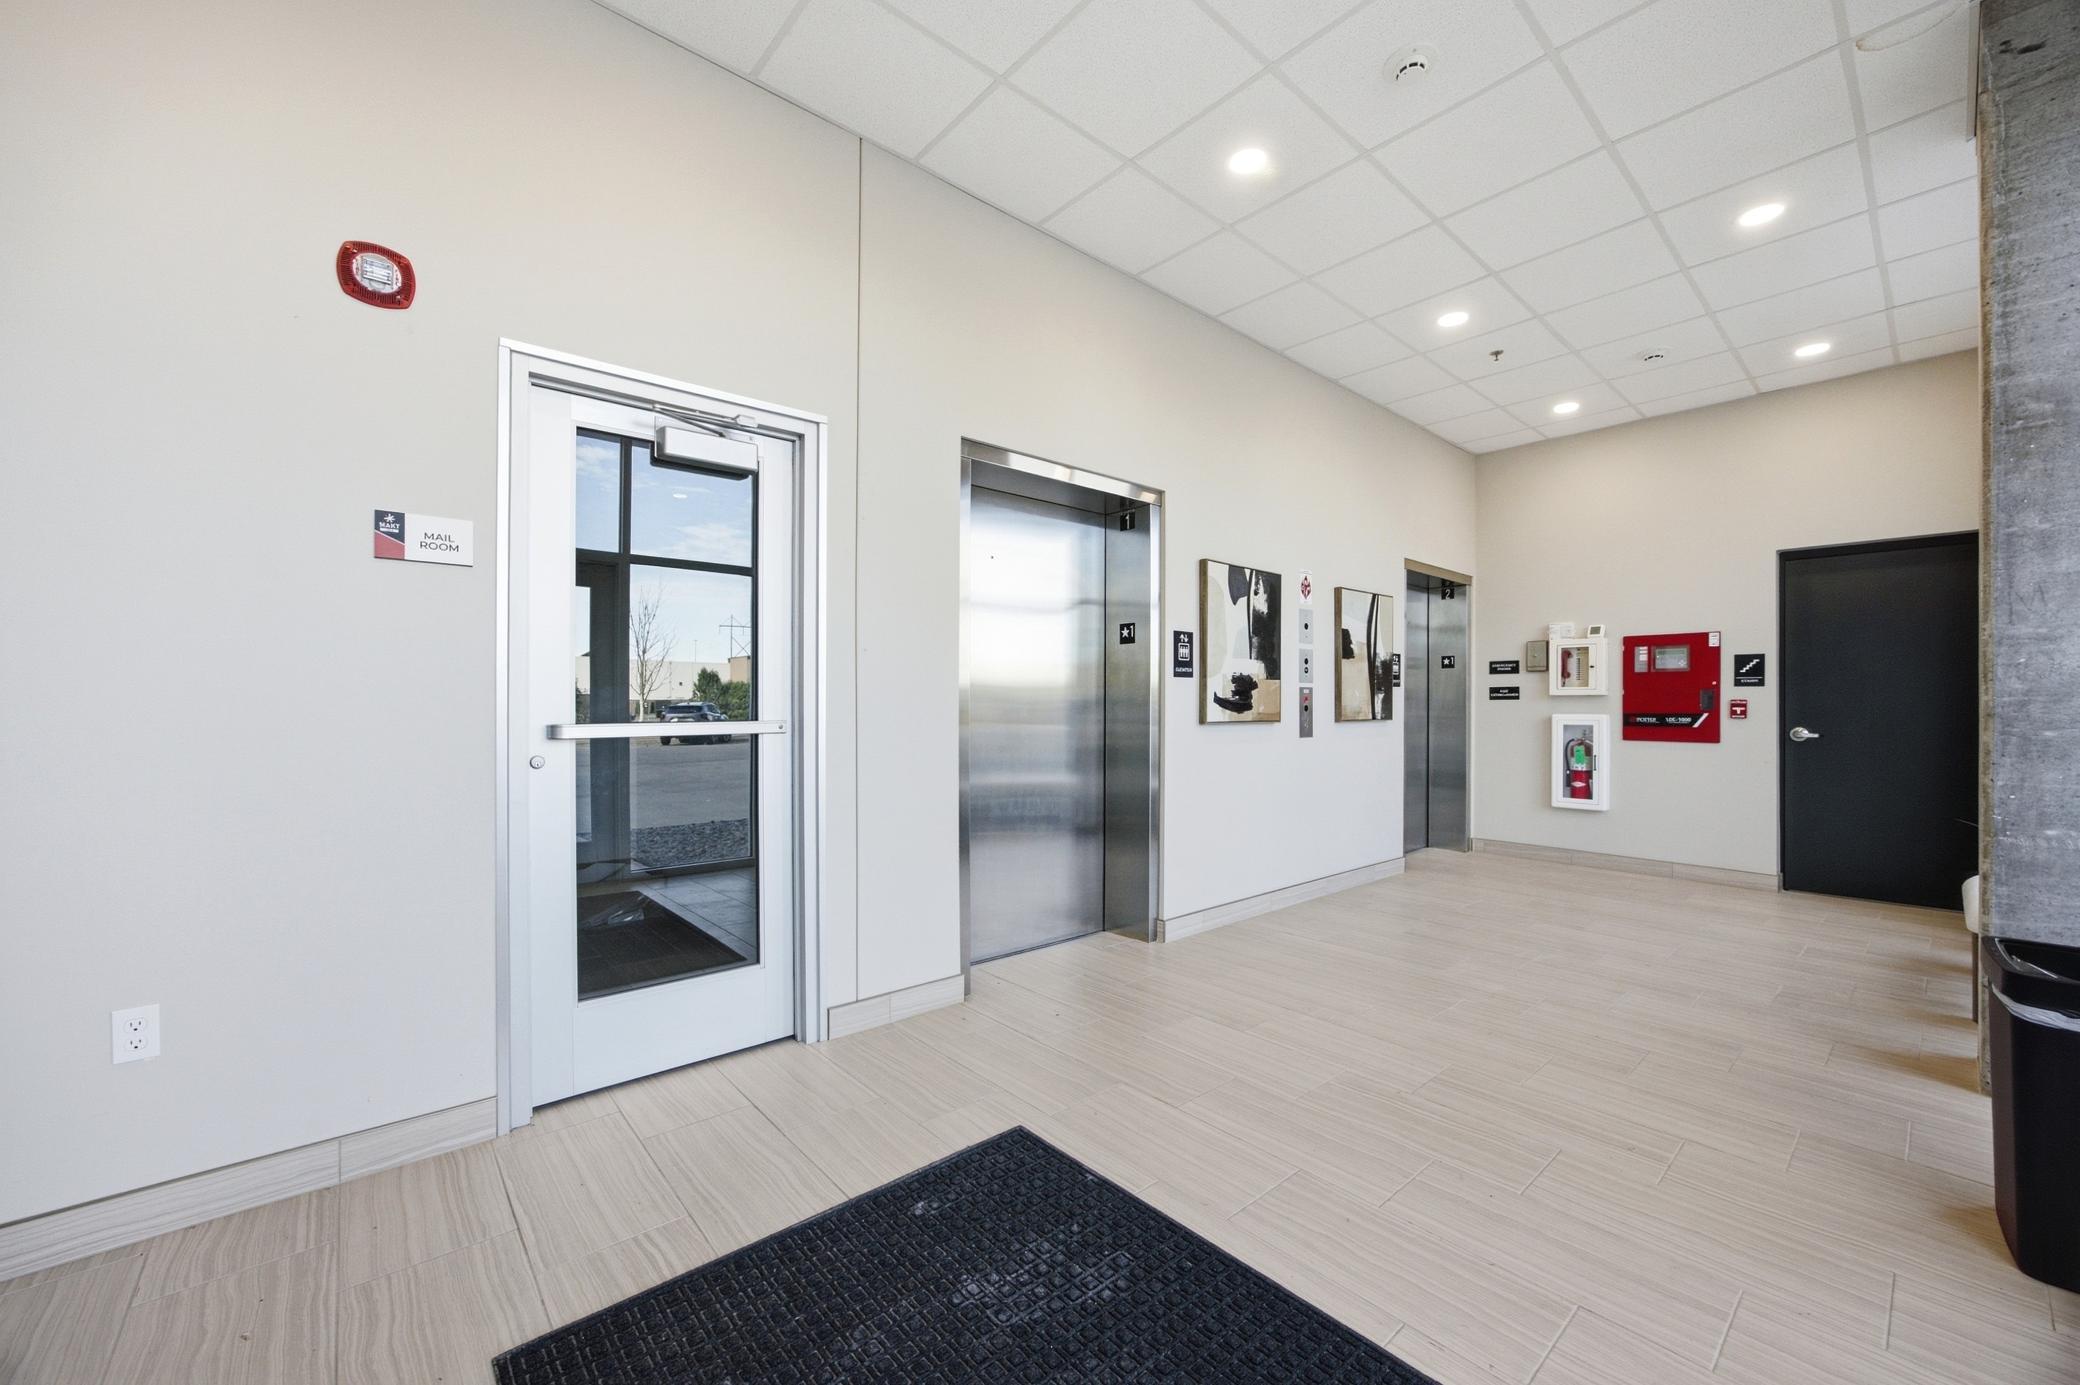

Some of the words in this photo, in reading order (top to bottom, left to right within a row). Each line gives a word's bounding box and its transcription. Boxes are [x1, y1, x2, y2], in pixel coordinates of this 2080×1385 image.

[424, 532, 455, 543] MAIL
[420, 541, 459, 552] ROOM
[1445, 589, 1451, 600] 2
